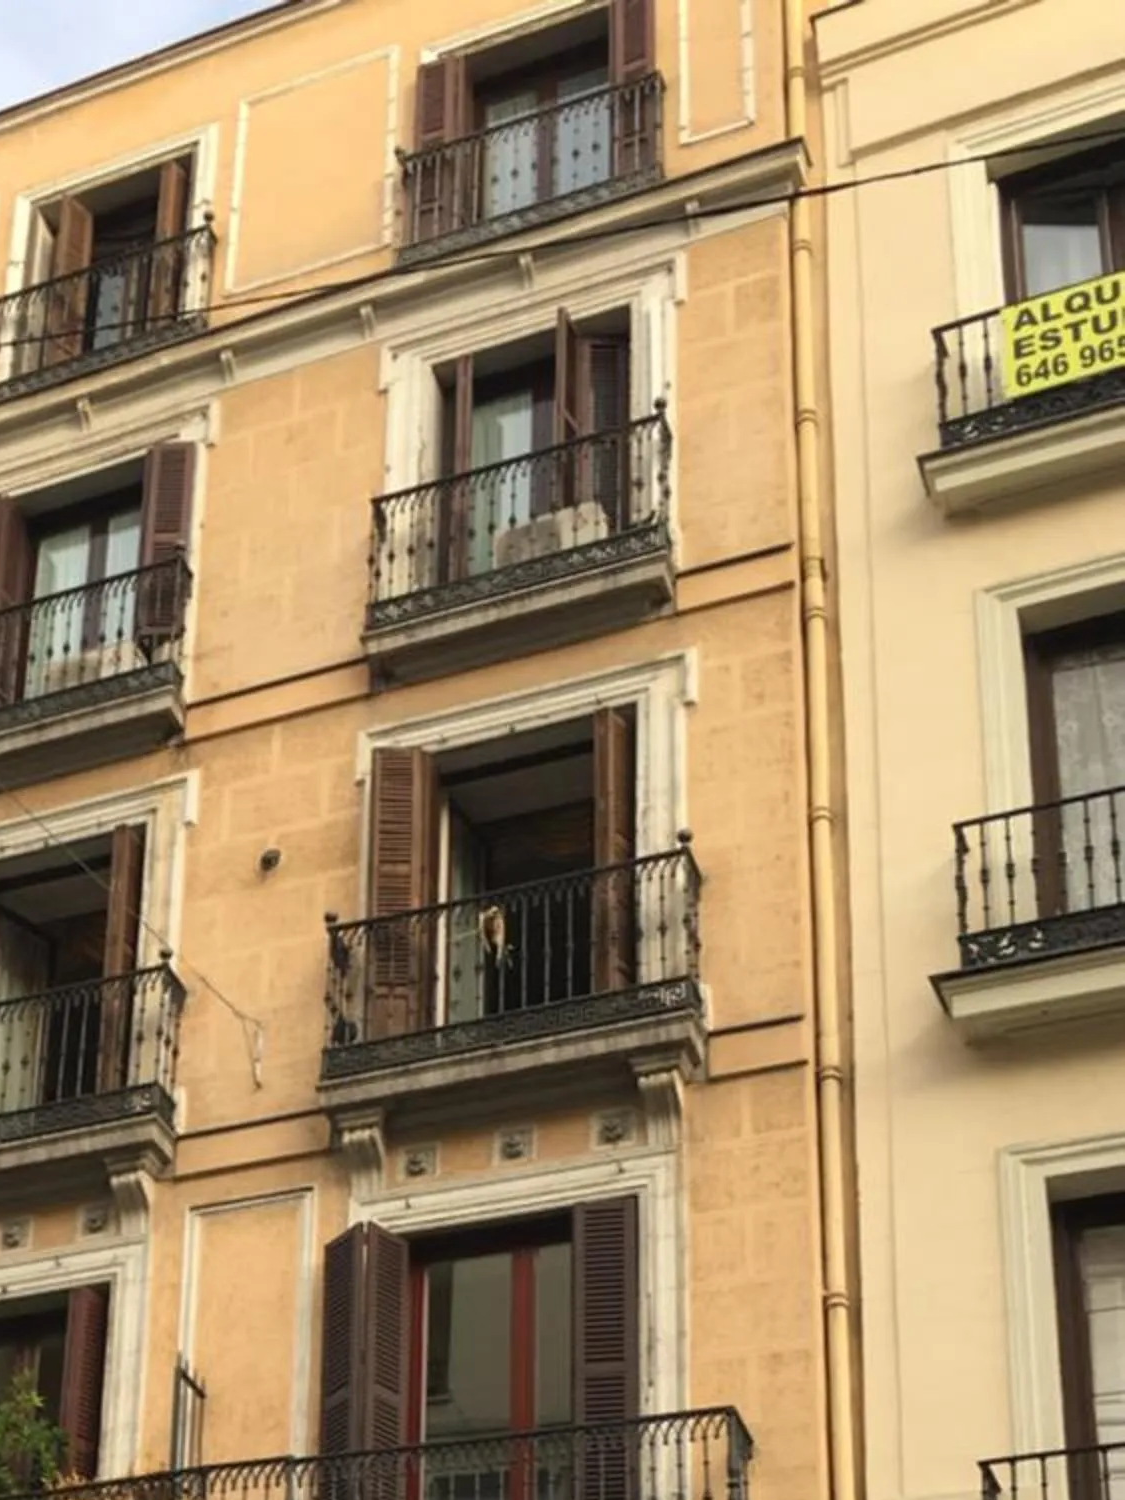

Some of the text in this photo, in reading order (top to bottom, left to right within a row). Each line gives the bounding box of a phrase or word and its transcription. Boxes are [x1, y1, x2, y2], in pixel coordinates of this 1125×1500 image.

[1013, 280, 1121, 332] ALQU
[1013, 307, 1125, 359] ESTU
[1015, 353, 1069, 387] 646
